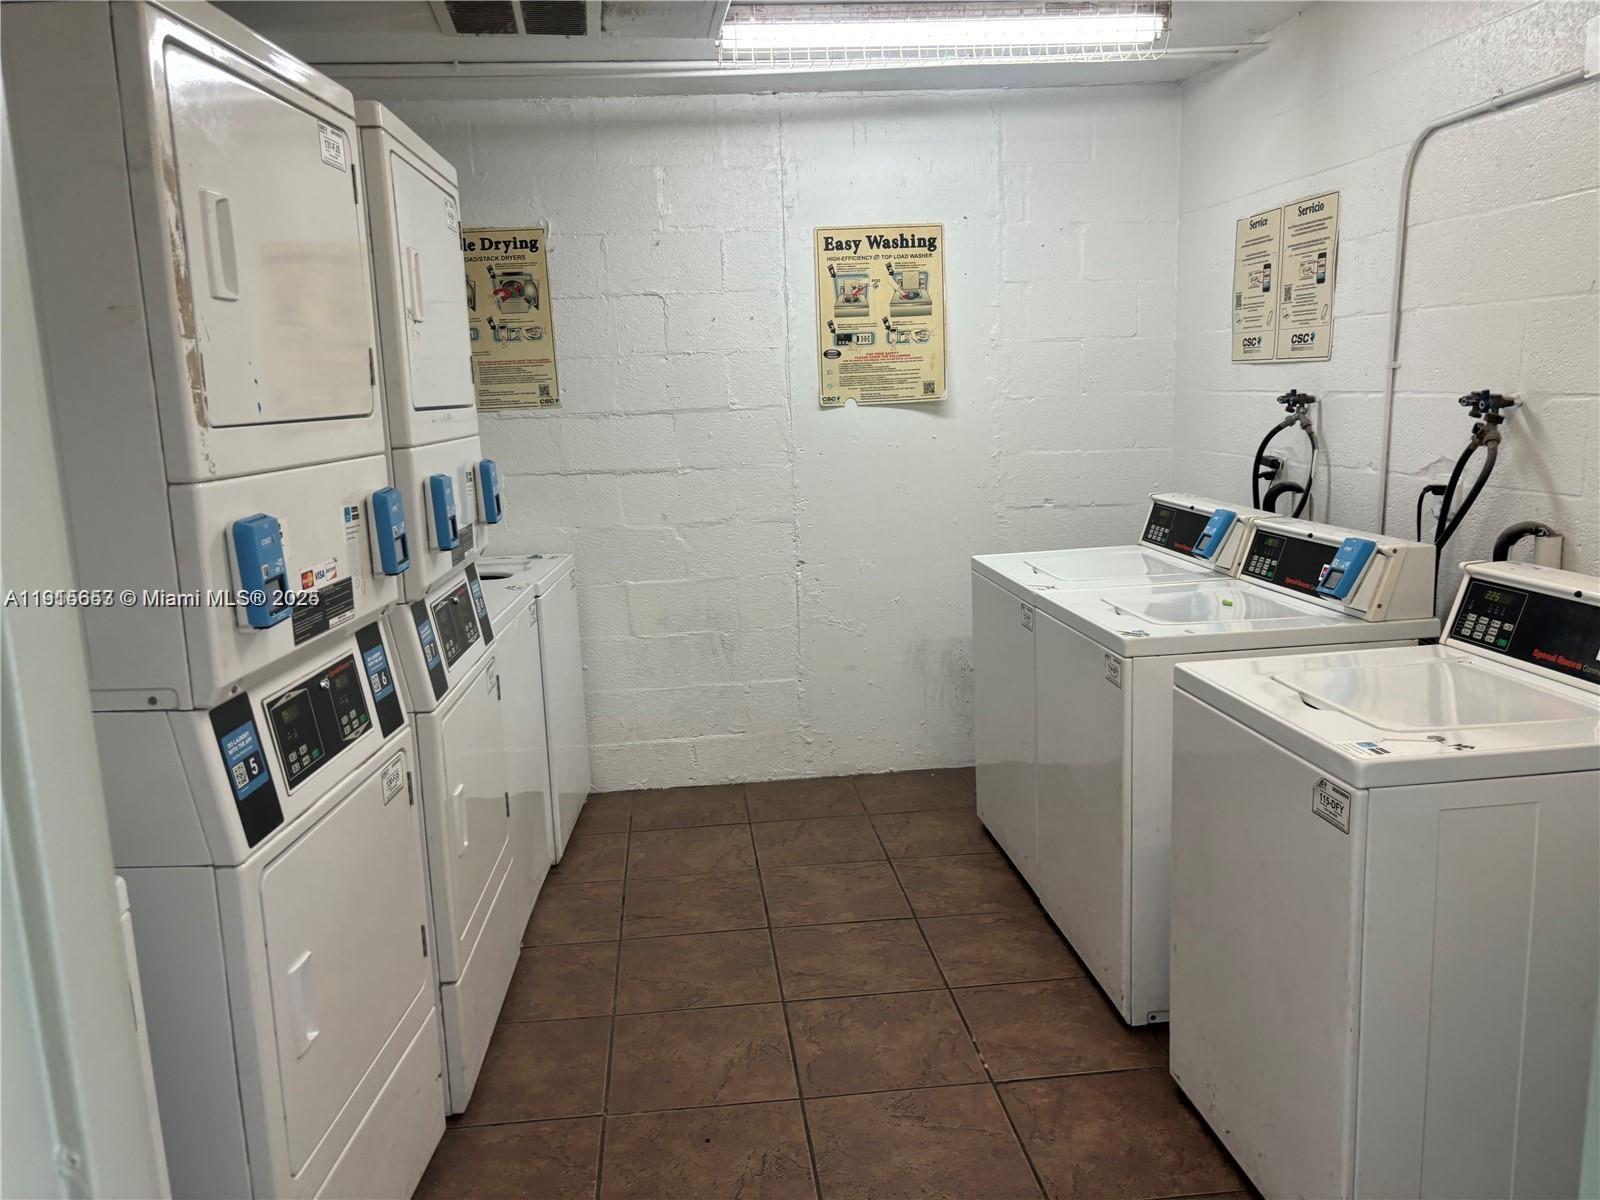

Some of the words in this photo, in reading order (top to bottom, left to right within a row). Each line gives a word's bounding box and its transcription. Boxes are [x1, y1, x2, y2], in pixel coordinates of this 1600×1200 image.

[1298, 200, 1324, 216] Servicio
[1249, 217, 1268, 230] Service
[480, 236, 539, 254] Drying
[823, 236, 862, 254] Easy
[865, 233, 937, 252] Washing
[1242, 337, 1257, 347] CSC
[1291, 333, 1309, 344] CSC
[1532, 649, 1557, 663] Speed
[1556, 655, 1582, 670] Queen
[381, 671, 387, 685] 6
[249, 757, 259, 775] 5
[1320, 793, 1344, 815] 115-DFY
